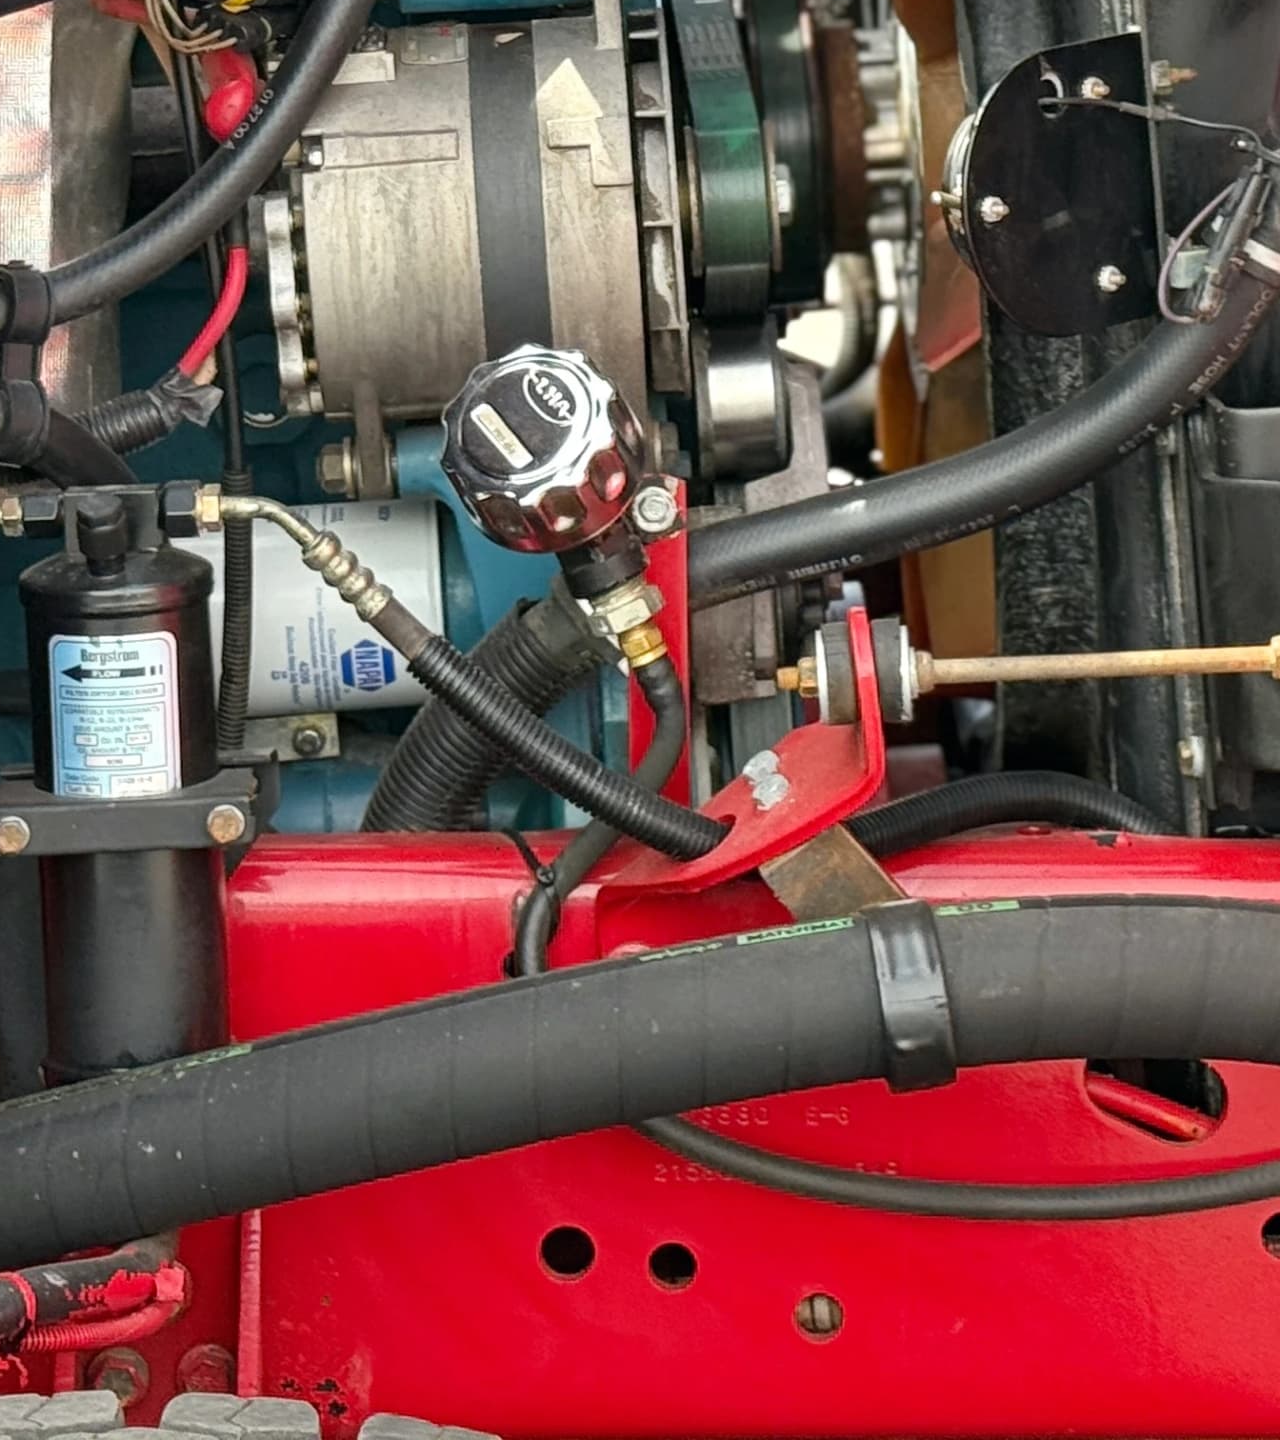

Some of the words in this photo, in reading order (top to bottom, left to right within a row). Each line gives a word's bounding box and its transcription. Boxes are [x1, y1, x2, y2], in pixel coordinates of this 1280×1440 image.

[1187, 355, 1227, 395] HOSE
[81, 649, 140, 667] Bergstrom
[354, 648, 384, 688] NAPA
